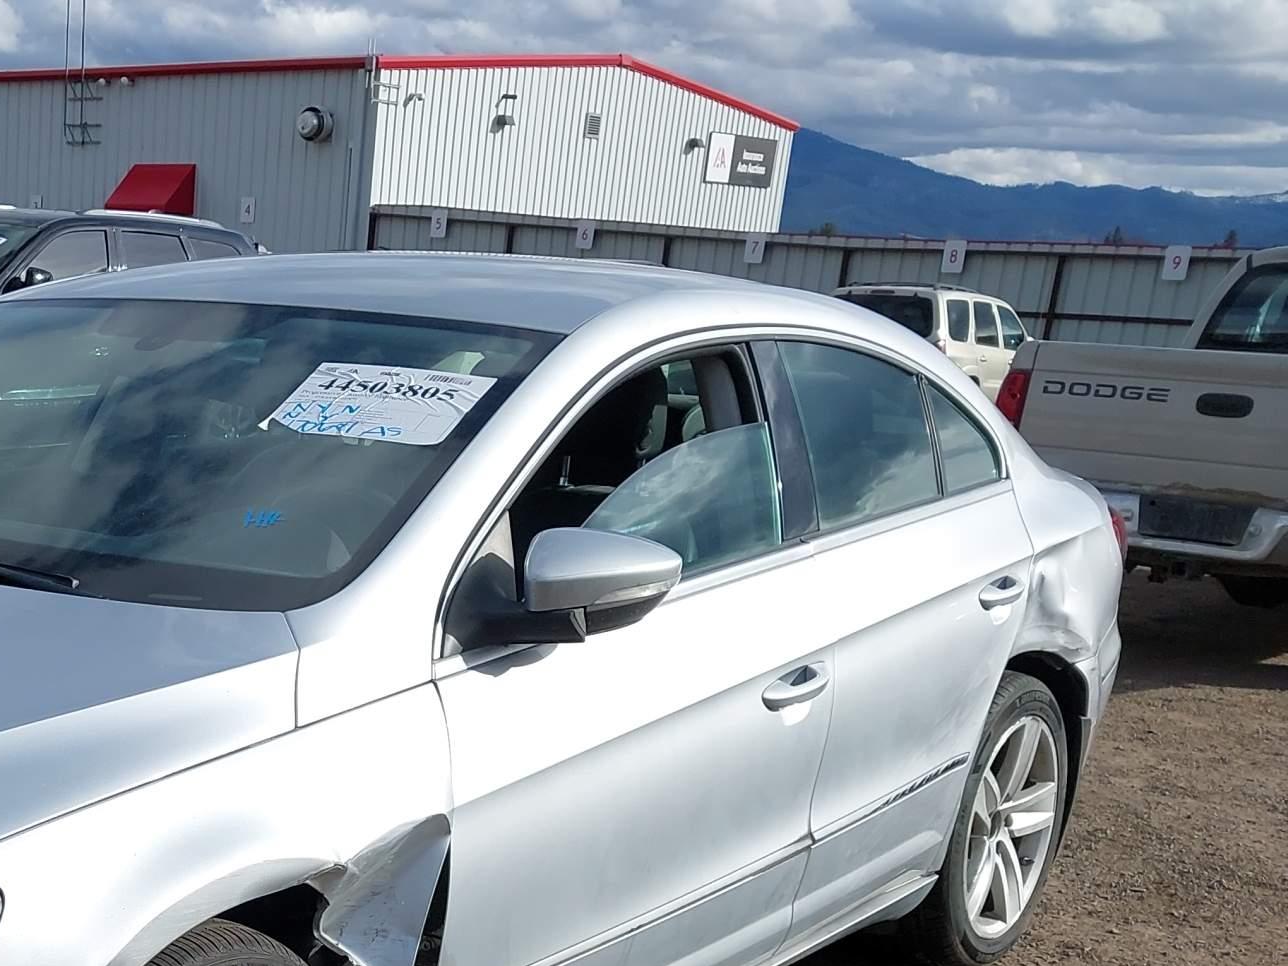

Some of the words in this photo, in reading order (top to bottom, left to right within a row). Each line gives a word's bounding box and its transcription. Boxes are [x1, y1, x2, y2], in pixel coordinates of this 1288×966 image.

[244, 204, 251, 216] 4
[436, 216, 442, 231] 5
[581, 228, 588, 241] 6
[751, 240, 760, 255] 7
[949, 248, 958, 264] 8
[1172, 255, 1182, 271] 9
[319, 378, 461, 401] 44503805
[1042, 380, 1171, 403] DODGE
